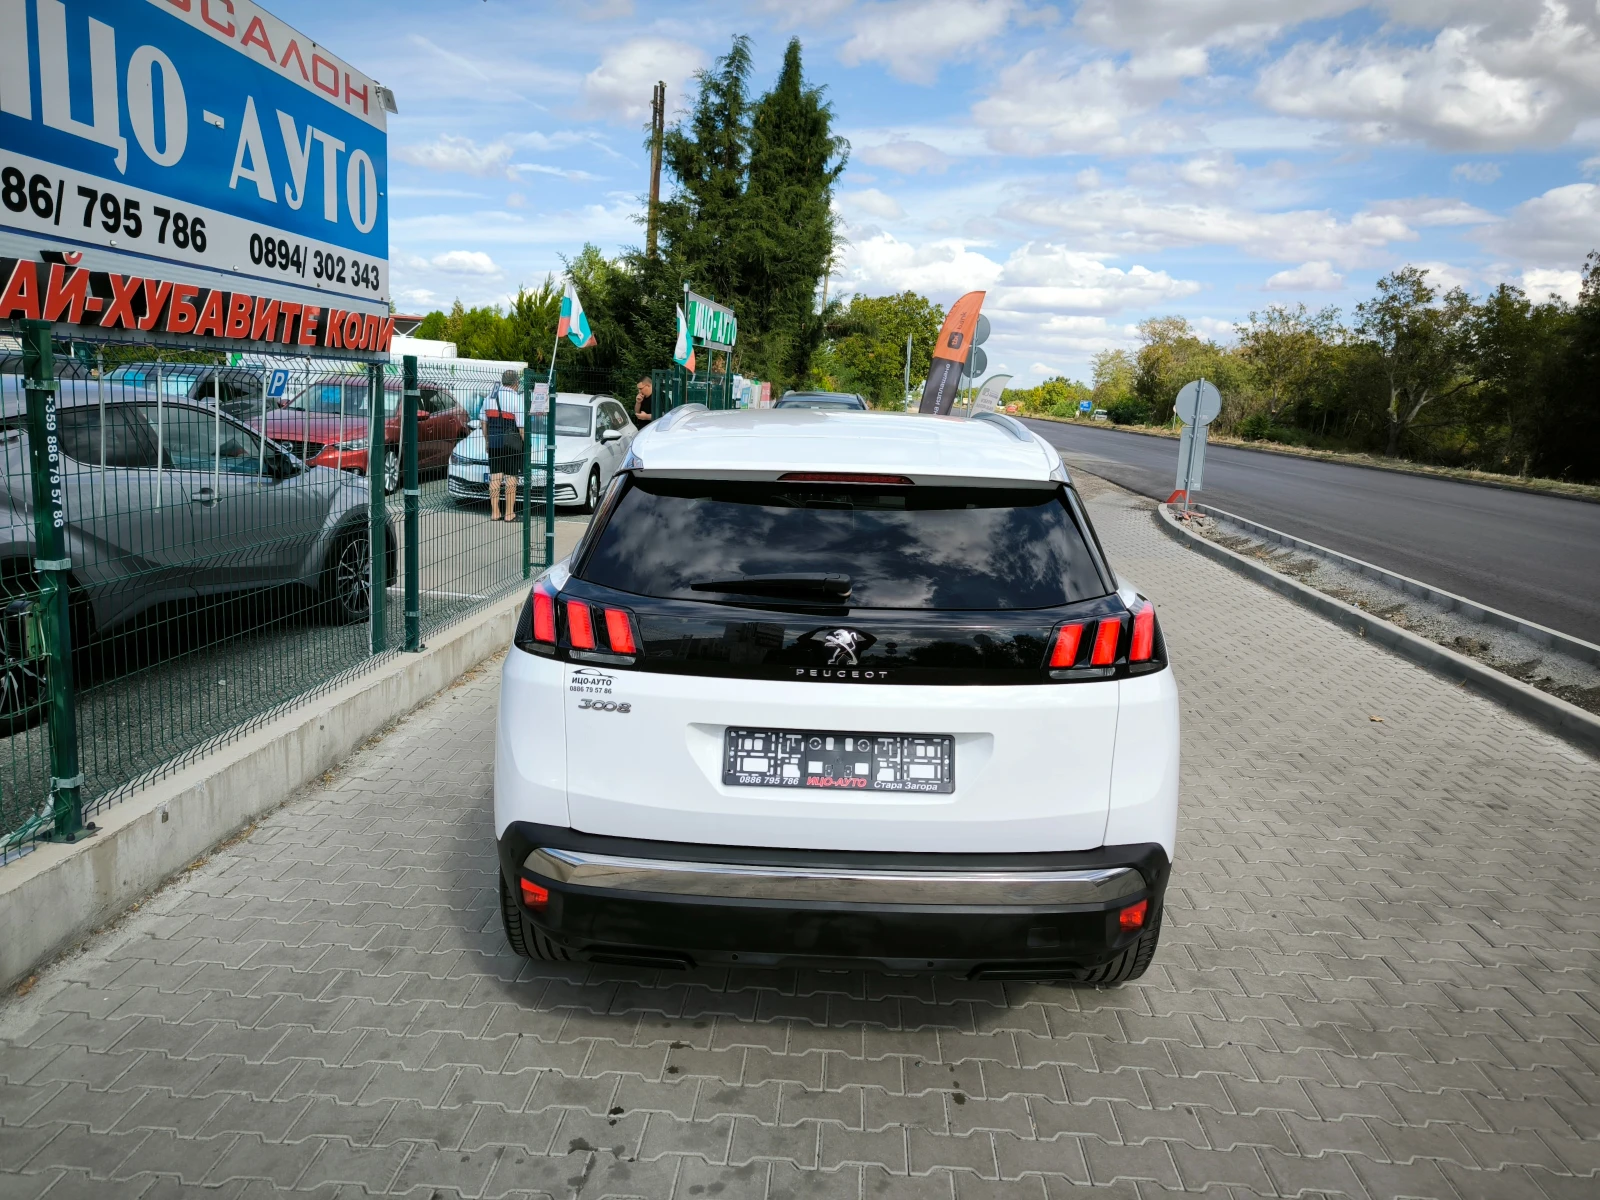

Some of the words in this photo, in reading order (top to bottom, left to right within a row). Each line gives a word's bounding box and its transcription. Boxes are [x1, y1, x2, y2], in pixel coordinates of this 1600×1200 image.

[166, 0, 369, 116] САЛОН
[77, 185, 143, 238] 795
[153, 206, 207, 253] 786
[250, 233, 308, 279] 0894/
[313, 250, 346, 284] 302
[351, 260, 380, 291] 343
[0, 251, 321, 347] АЙ-ХУБАВИТЕ
[324, 308, 395, 352] КОЛИ
[694, 301, 738, 347] ИЦО-АУТО
[270, 372, 285, 394] P
[45, 395, 56, 431] +359
[47, 435, 58, 463] 886
[49, 466, 60, 484] 79
[51, 488, 62, 505] 57
[53, 510, 64, 528] 86
[571, 677, 612, 686] ИЦО-АУТО
[796, 668, 888, 679] PEUGEOT
[578, 698, 632, 713] 3008
[739, 776, 761, 784] 0886
[764, 777, 780, 785] 795
[806, 776, 868, 788] ИЦО-АУТО
[874, 781, 902, 790] Стара
[904, 782, 938, 791] Загора
